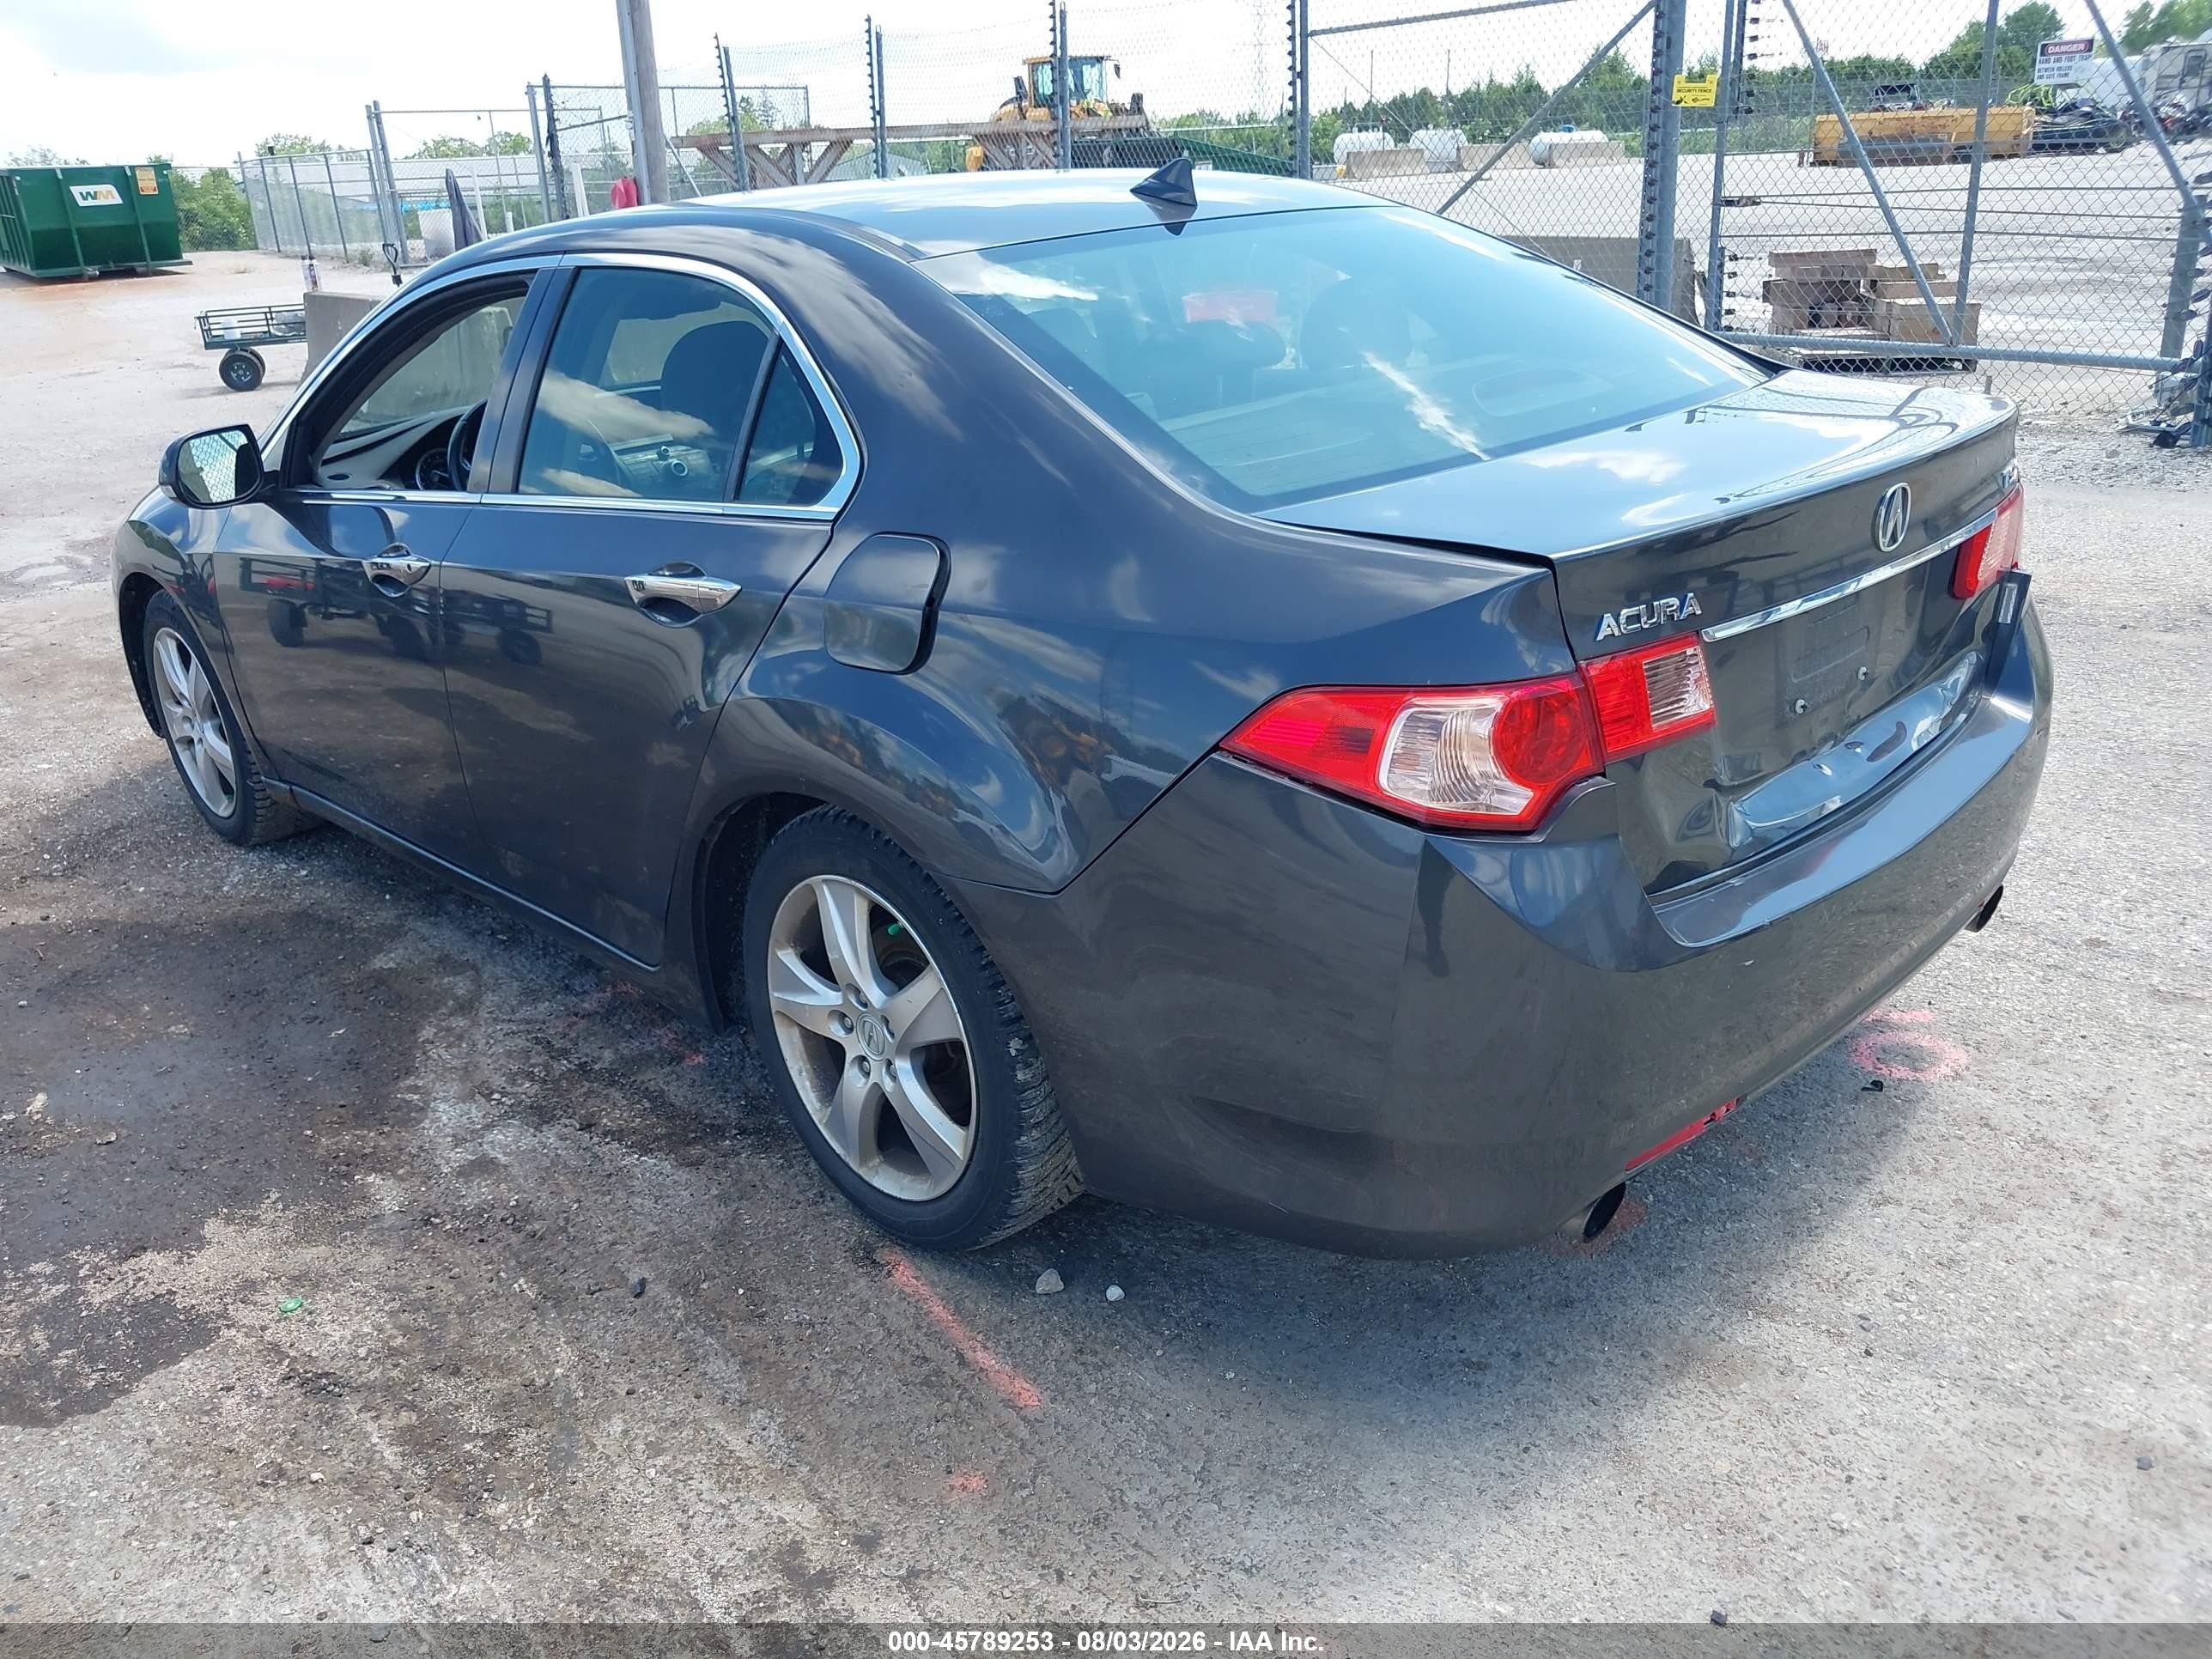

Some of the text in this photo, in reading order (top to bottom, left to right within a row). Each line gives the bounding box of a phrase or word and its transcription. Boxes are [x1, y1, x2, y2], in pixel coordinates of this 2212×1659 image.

[2047, 43, 2086, 54] DANGER
[79, 190, 116, 202] WM
[1595, 592, 1703, 641] ACURA
